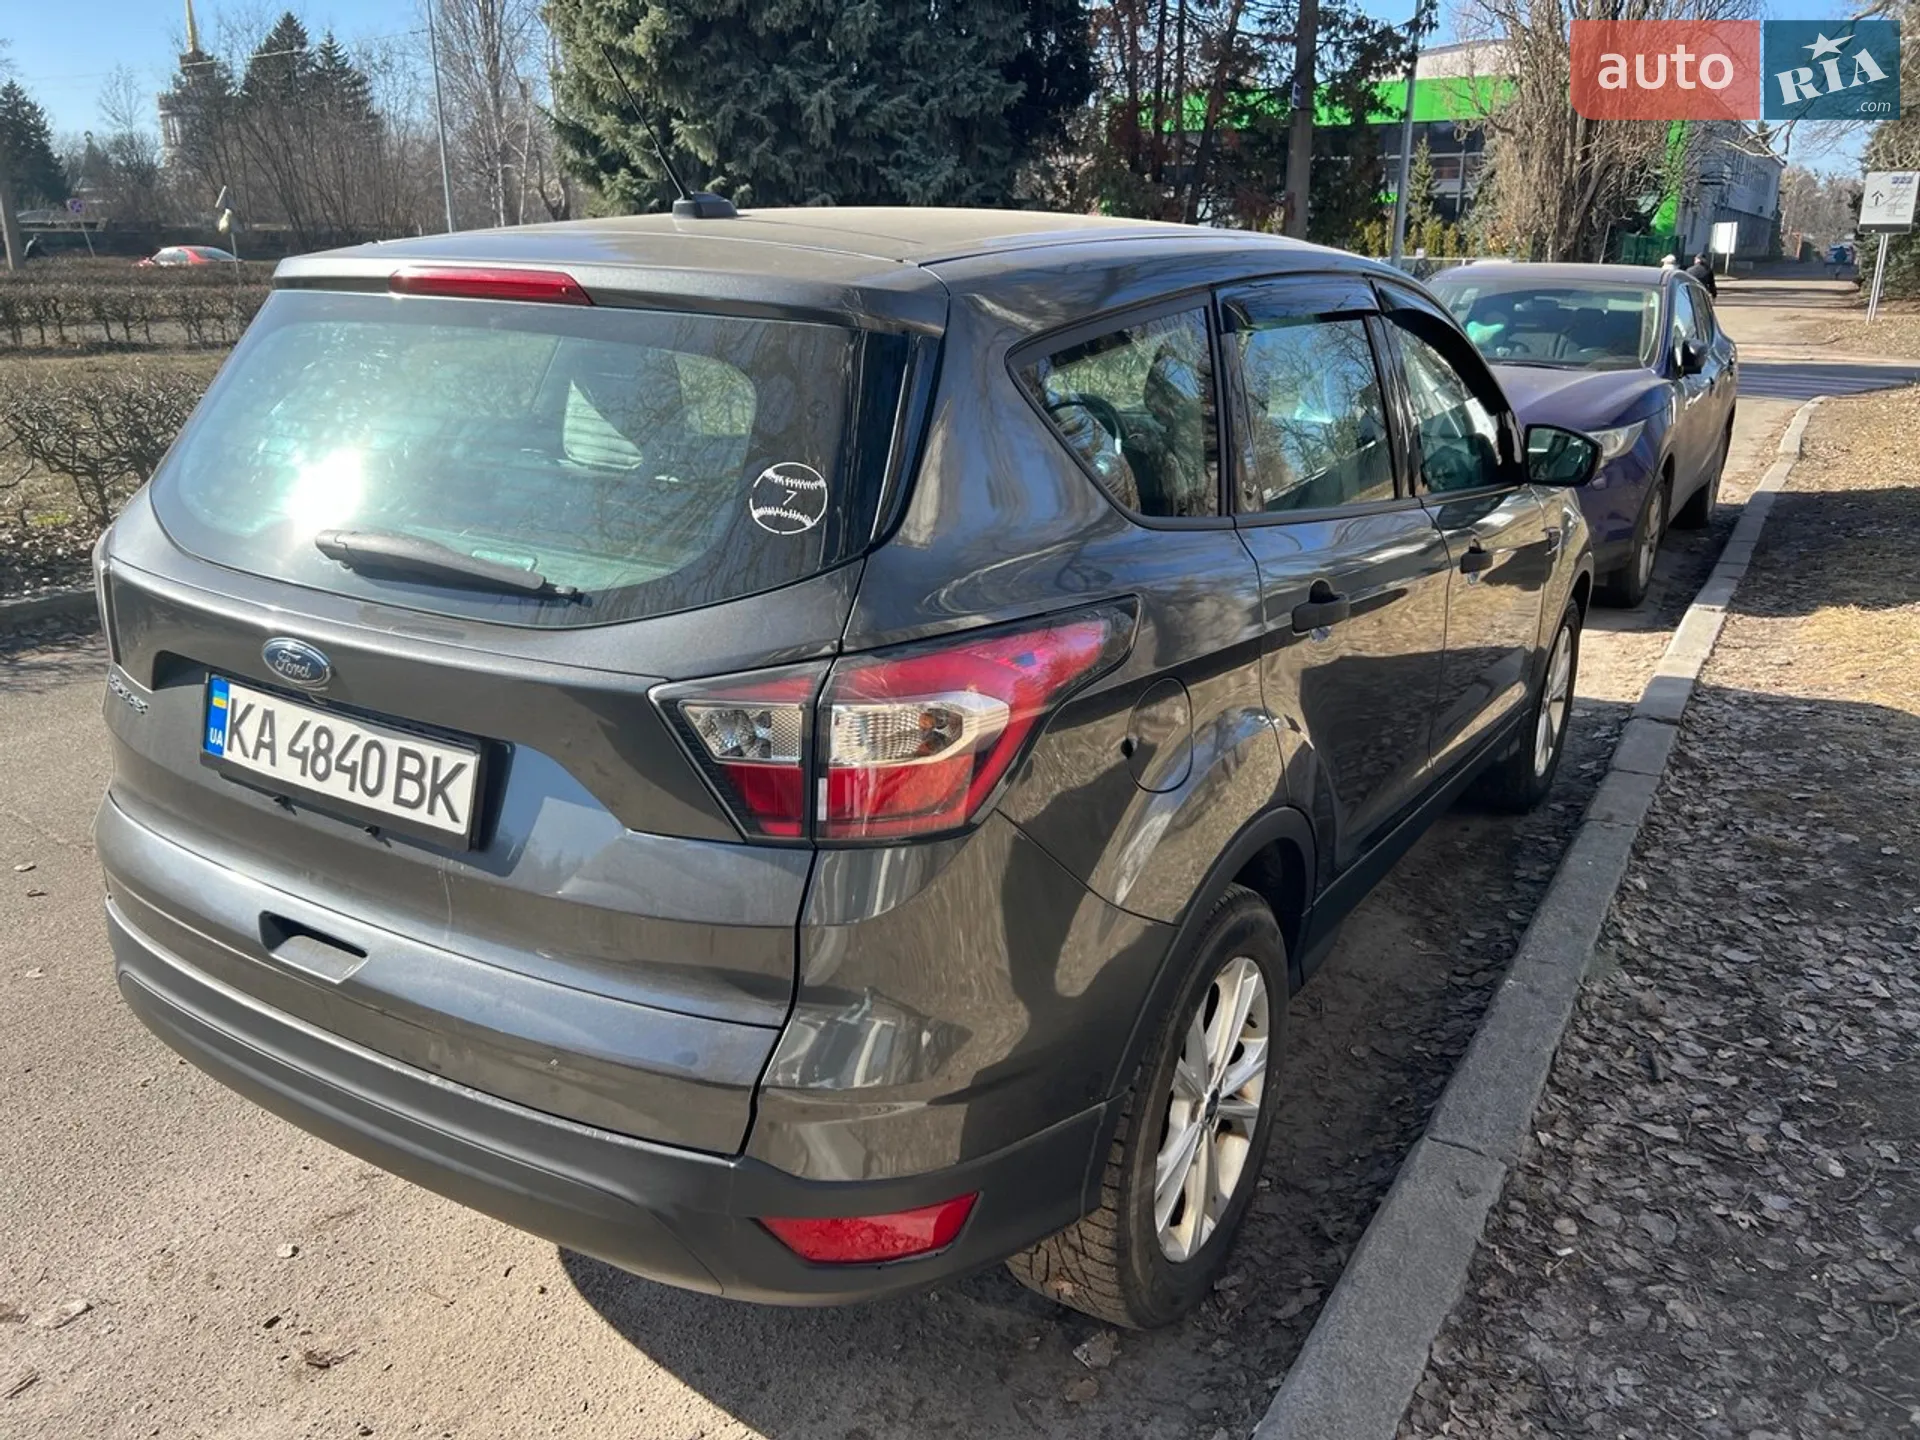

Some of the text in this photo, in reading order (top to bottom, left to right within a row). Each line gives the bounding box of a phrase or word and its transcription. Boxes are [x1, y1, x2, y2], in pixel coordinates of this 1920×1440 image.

[782, 489, 798, 506] 7
[275, 649, 312, 679] Ford
[210, 727, 224, 747] UA
[227, 697, 468, 824] KA 4840 BK
